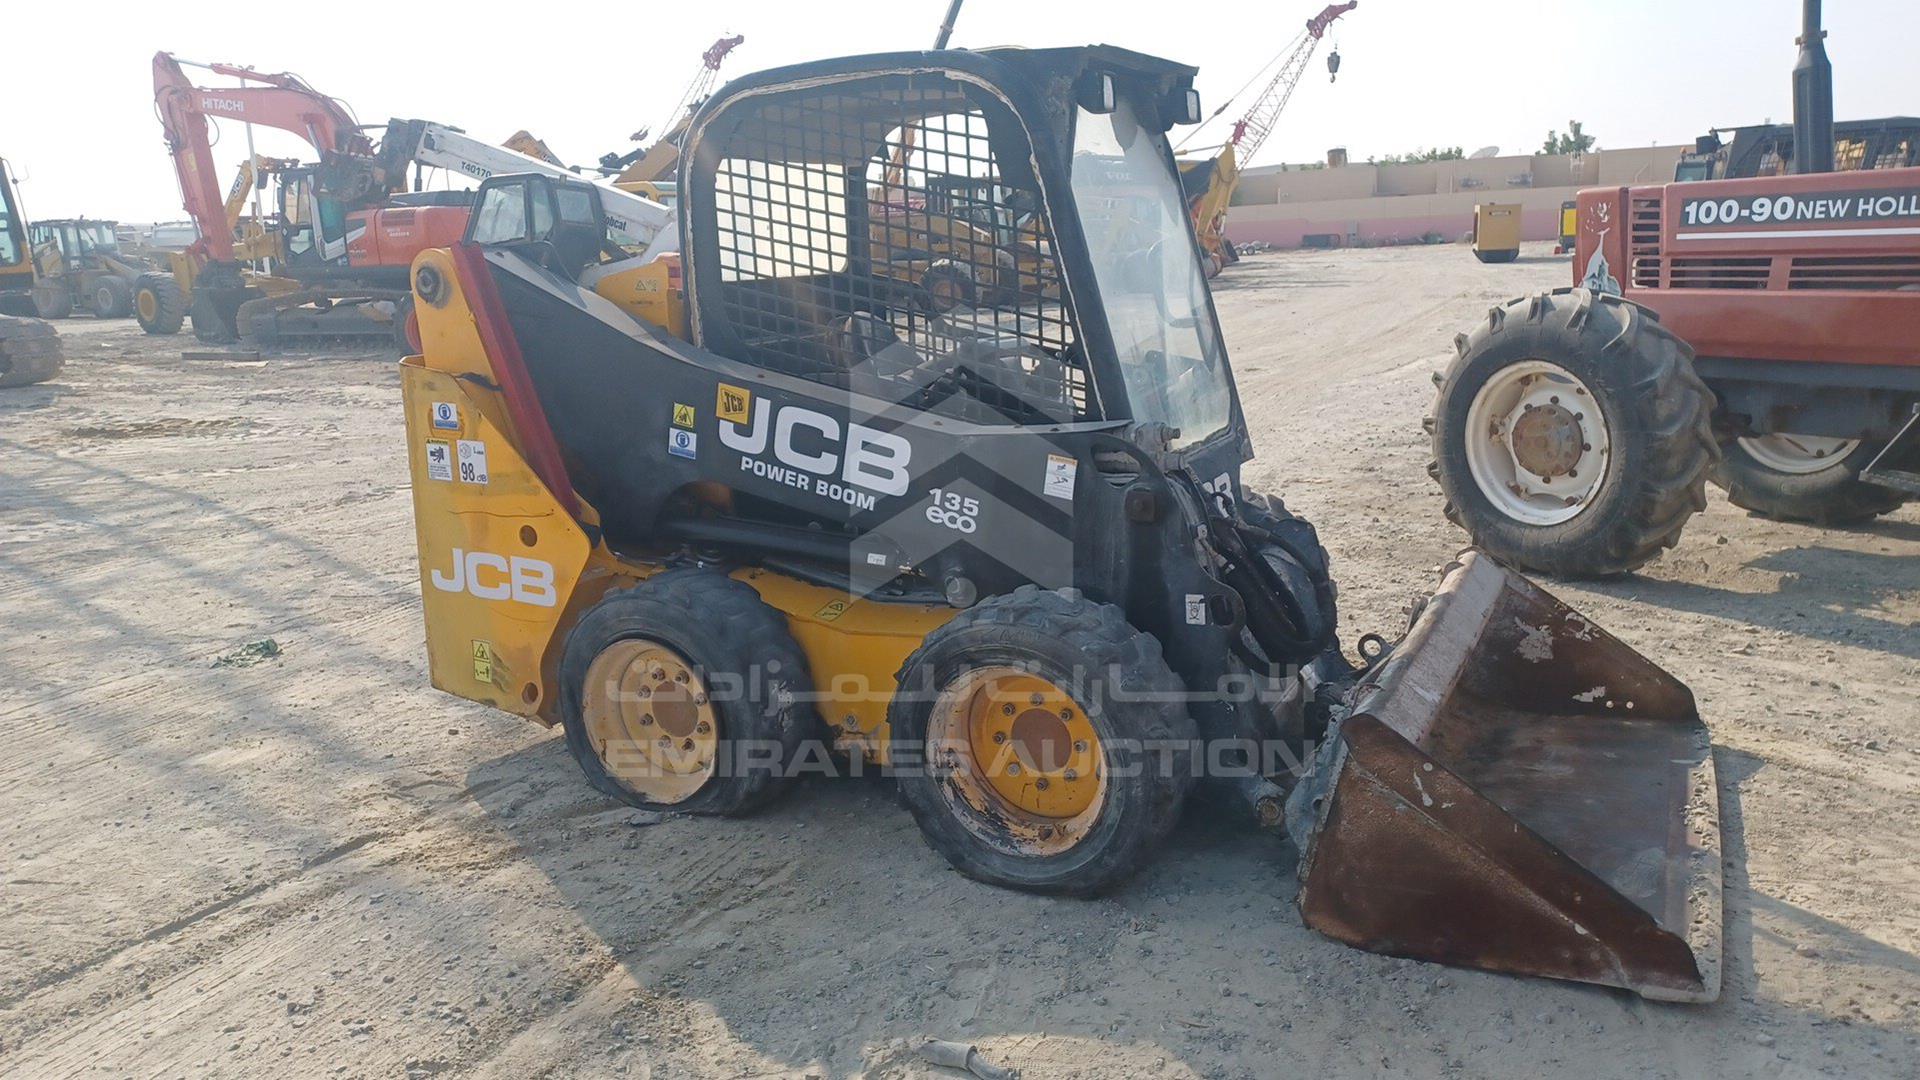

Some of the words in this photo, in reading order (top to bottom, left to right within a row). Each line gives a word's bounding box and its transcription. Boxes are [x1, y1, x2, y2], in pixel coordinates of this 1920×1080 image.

[202, 98, 244, 112] HITACHI
[602, 214, 627, 231] obcat
[1684, 195, 1796, 225] 100-90
[1796, 198, 1851, 220] NEW
[1856, 195, 1920, 219] HOLL
[724, 391, 744, 413] JCB
[718, 396, 912, 497] JCB
[461, 462, 475, 482] 98
[740, 455, 809, 491] POWER
[815, 479, 875, 511] BOOM
[929, 488, 979, 517] 135
[926, 505, 977, 534] eco
[431, 548, 556, 607] JCB
